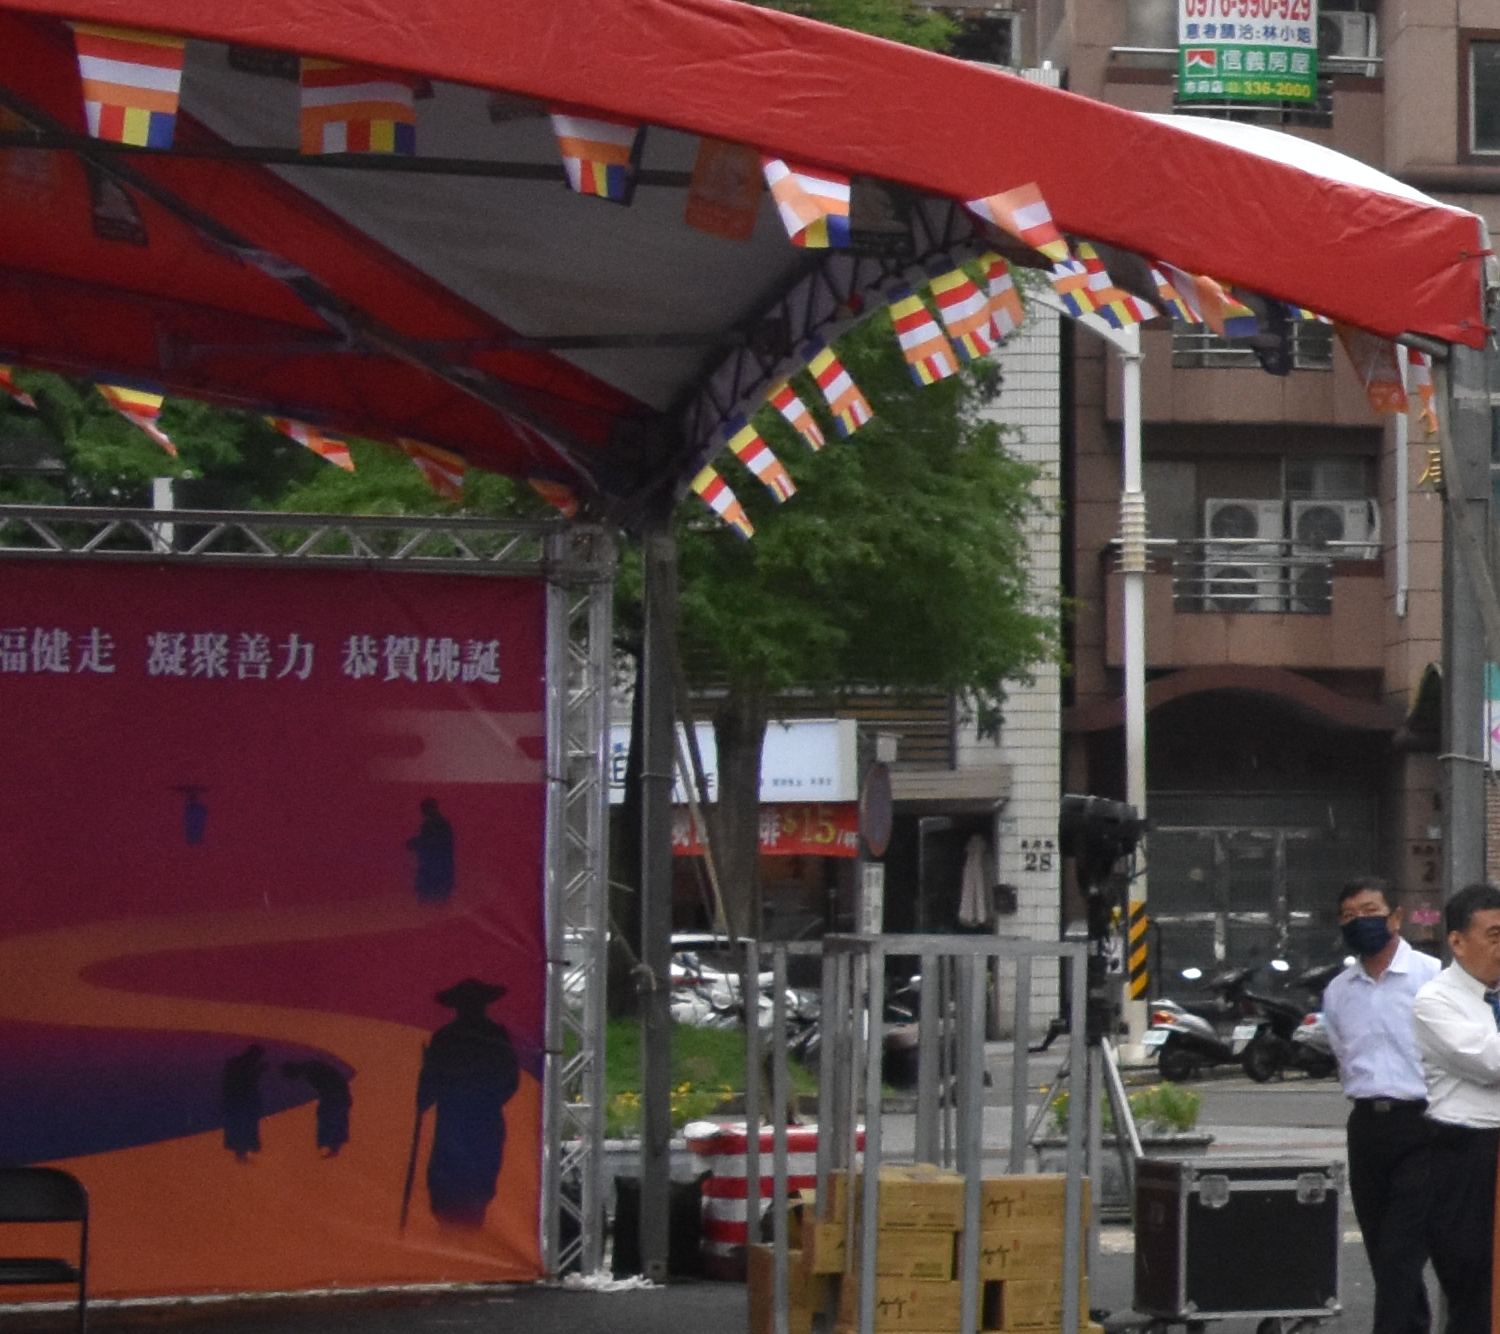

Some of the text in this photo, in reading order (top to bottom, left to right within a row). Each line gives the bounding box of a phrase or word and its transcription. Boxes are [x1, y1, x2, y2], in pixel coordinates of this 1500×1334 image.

[1222, 50, 1312, 75] 信義房屋
[146, 631, 315, 681] 凝聚善力
[341, 635, 501, 684] 恭賀佛誕
